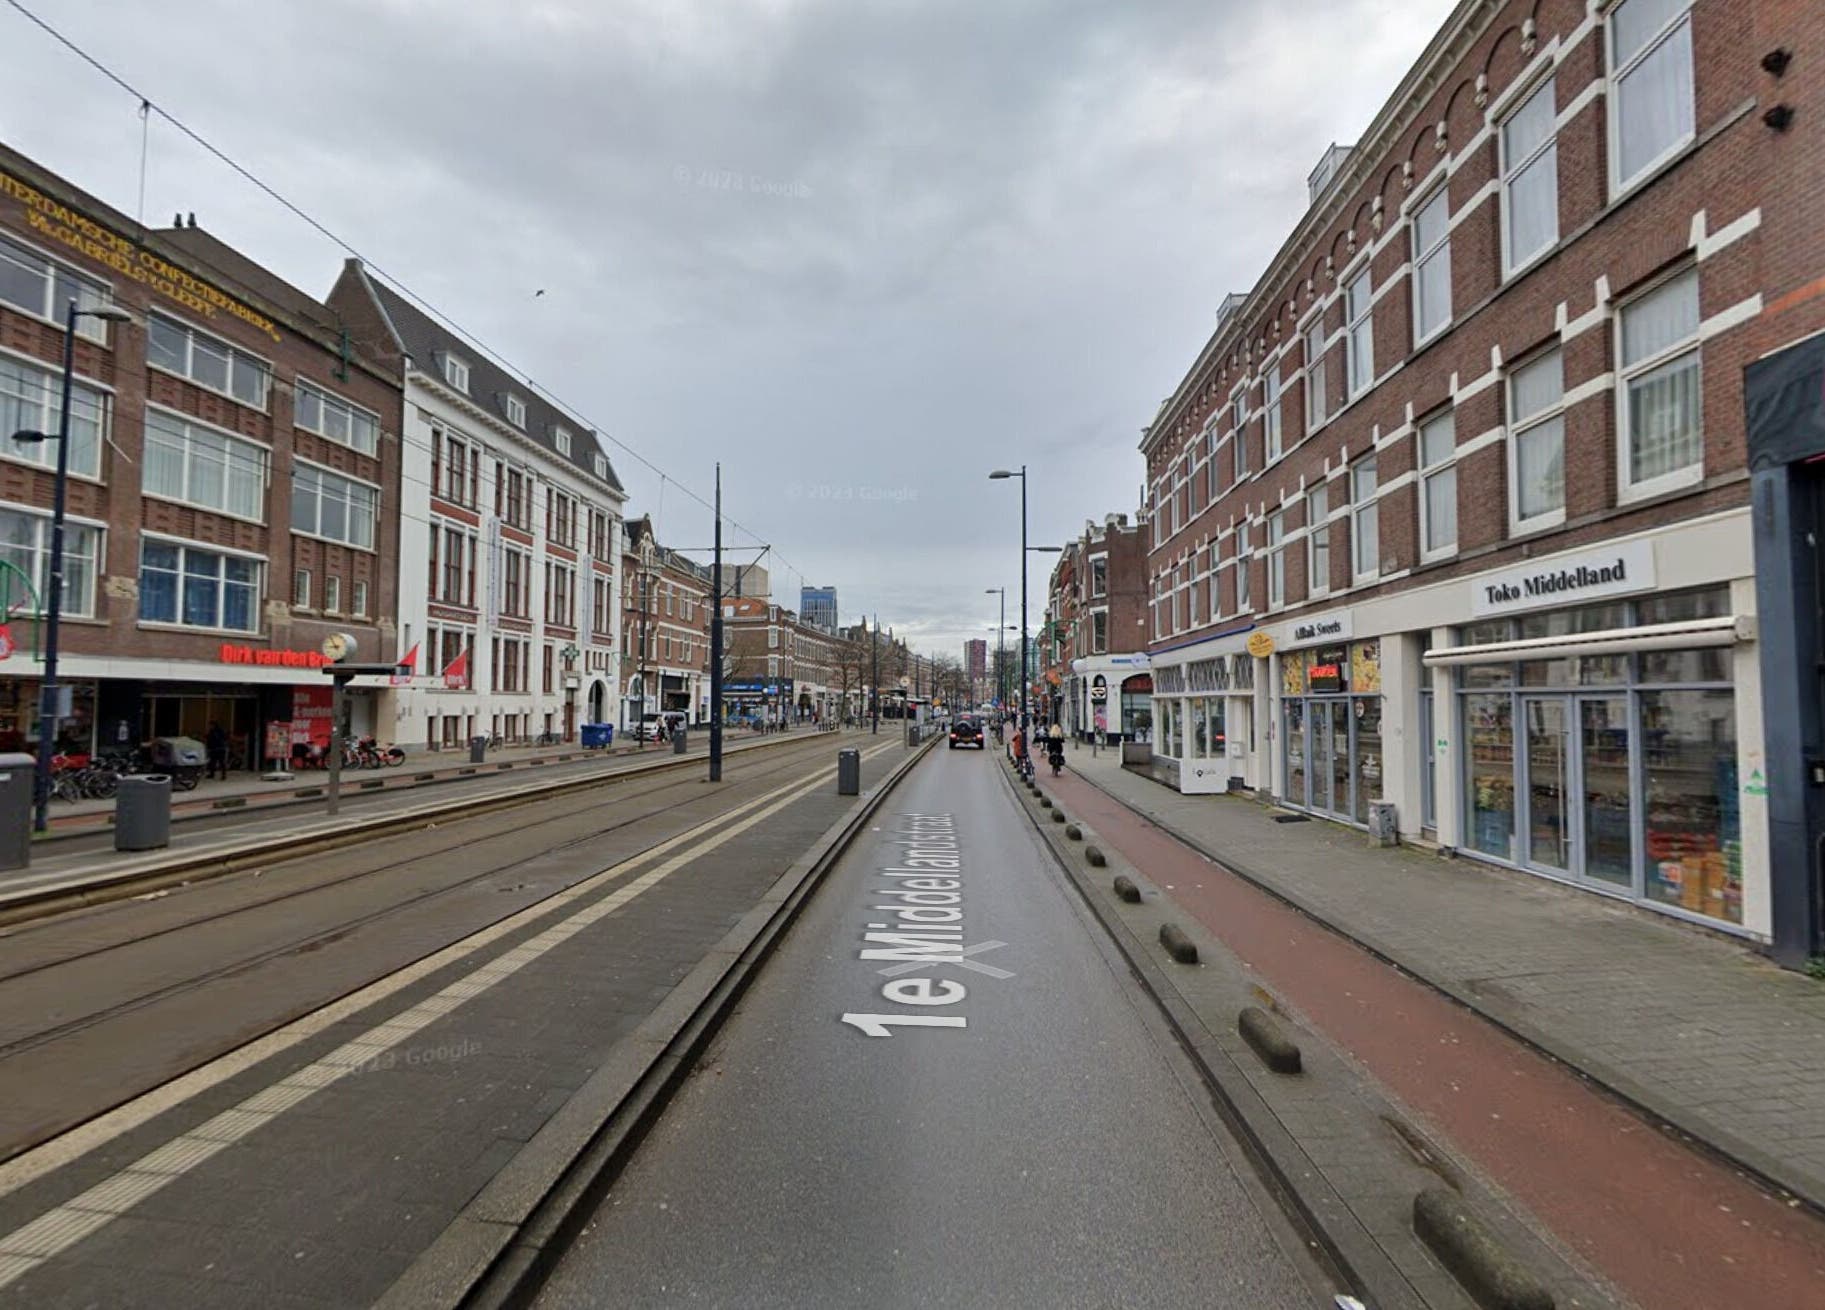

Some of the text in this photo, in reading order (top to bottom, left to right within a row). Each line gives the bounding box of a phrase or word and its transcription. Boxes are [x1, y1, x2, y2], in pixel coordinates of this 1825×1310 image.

[1485, 558, 1626, 604] Toko Middelland
[1316, 620, 1341, 636] Sweets
[220, 643, 253, 664] Dirk
[255, 648, 281, 666] van
[281, 648, 307, 667] den
